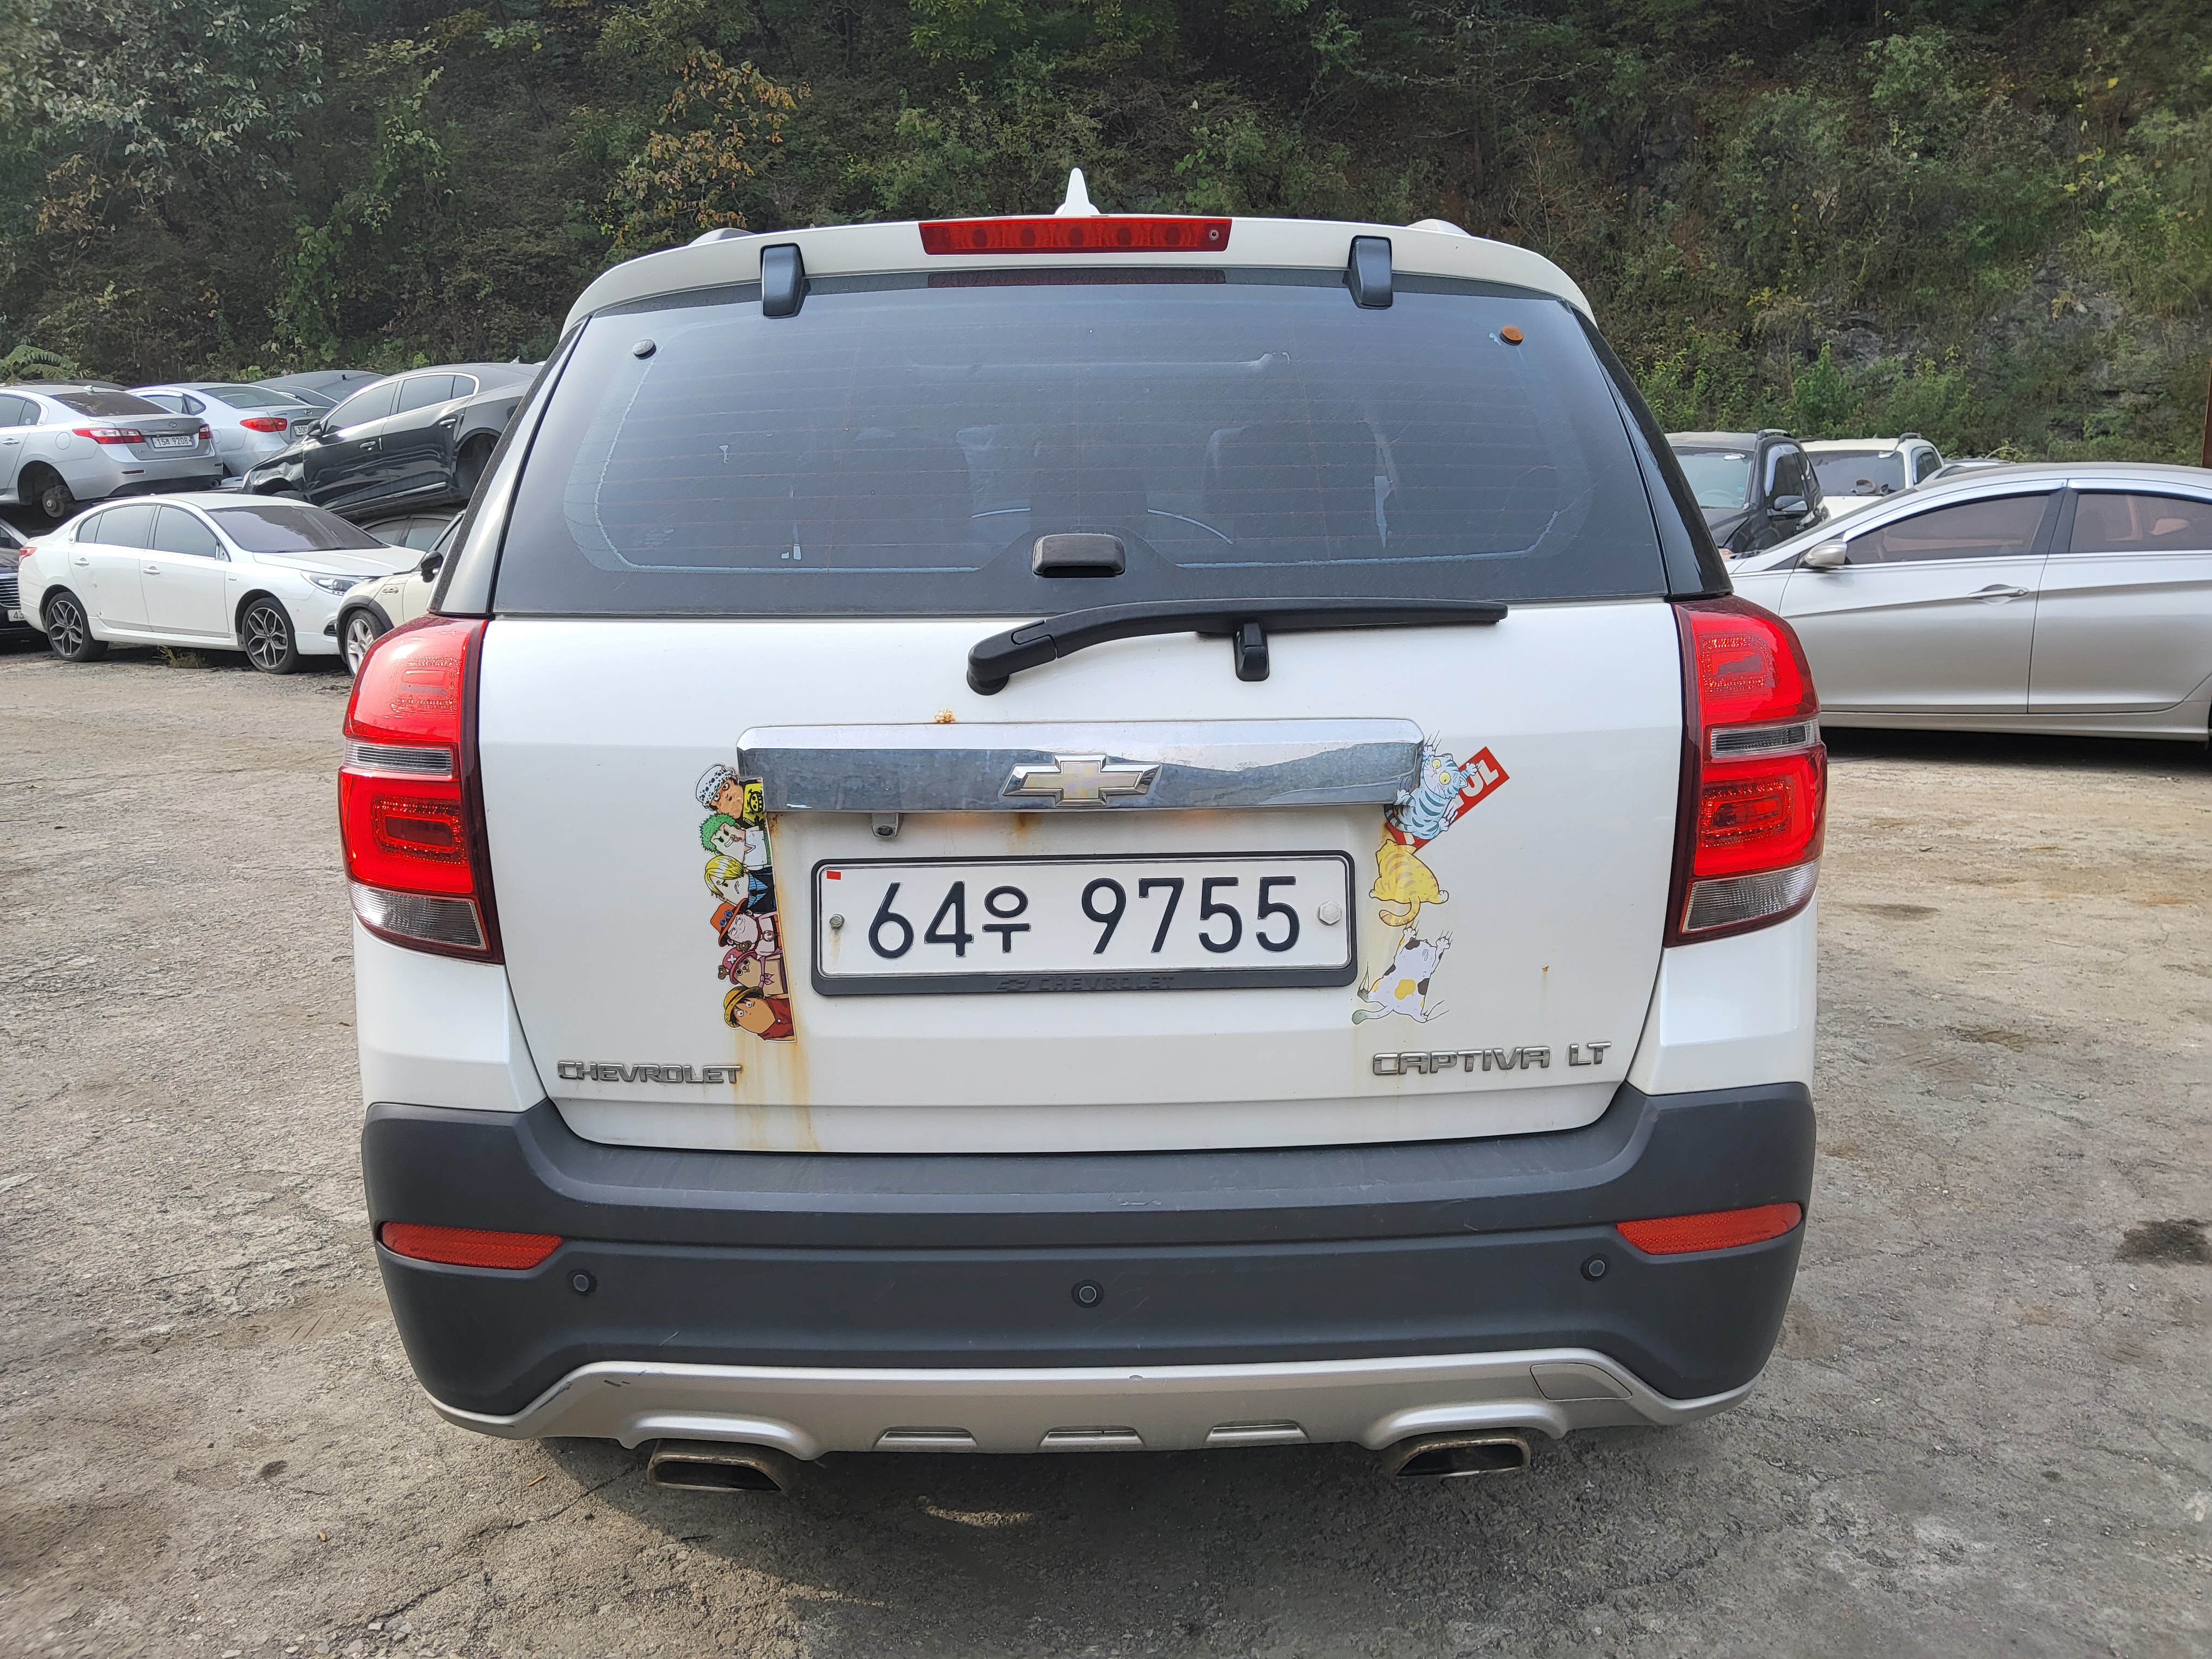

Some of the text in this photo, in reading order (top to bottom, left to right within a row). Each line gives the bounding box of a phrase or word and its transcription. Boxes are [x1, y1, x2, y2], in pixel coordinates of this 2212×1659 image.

[172, 437, 189, 445] 9208
[868, 876, 1300, 959] 64우 9755
[1038, 977, 1175, 991] CHEVROLET
[1373, 1041, 1612, 1076] CAPTIVA LT
[557, 1061, 742, 1084] CHEVROLET
